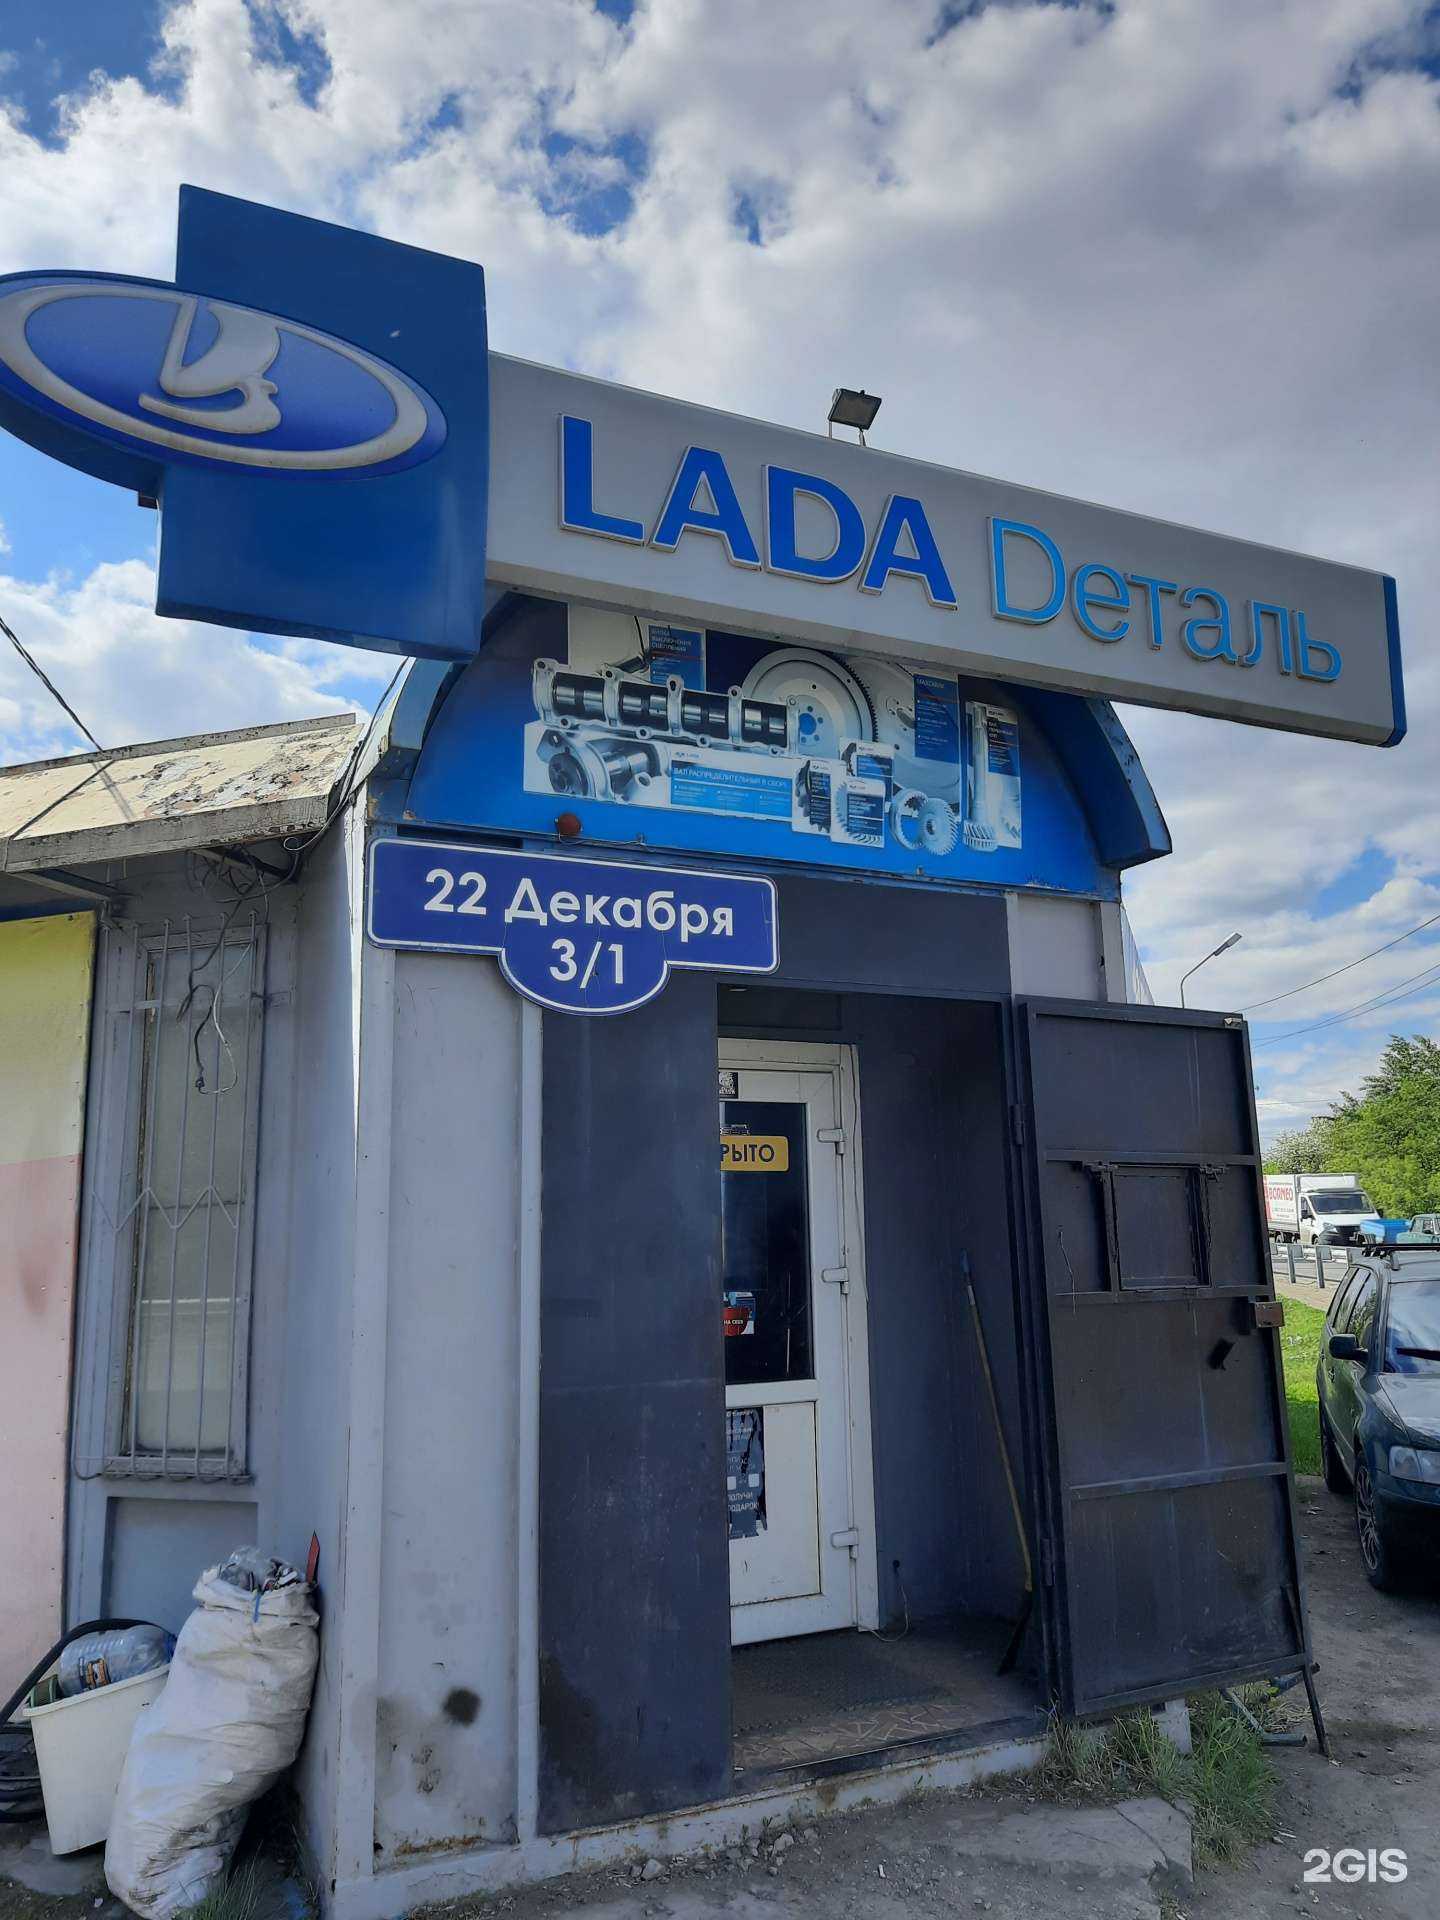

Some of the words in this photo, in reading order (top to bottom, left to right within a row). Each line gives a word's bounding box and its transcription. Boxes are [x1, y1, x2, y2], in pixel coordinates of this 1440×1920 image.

[559, 413, 958, 610] LADA
[424, 868, 487, 915] 22
[504, 877, 734, 943] Декабря
[549, 938, 624, 989] 3/1
